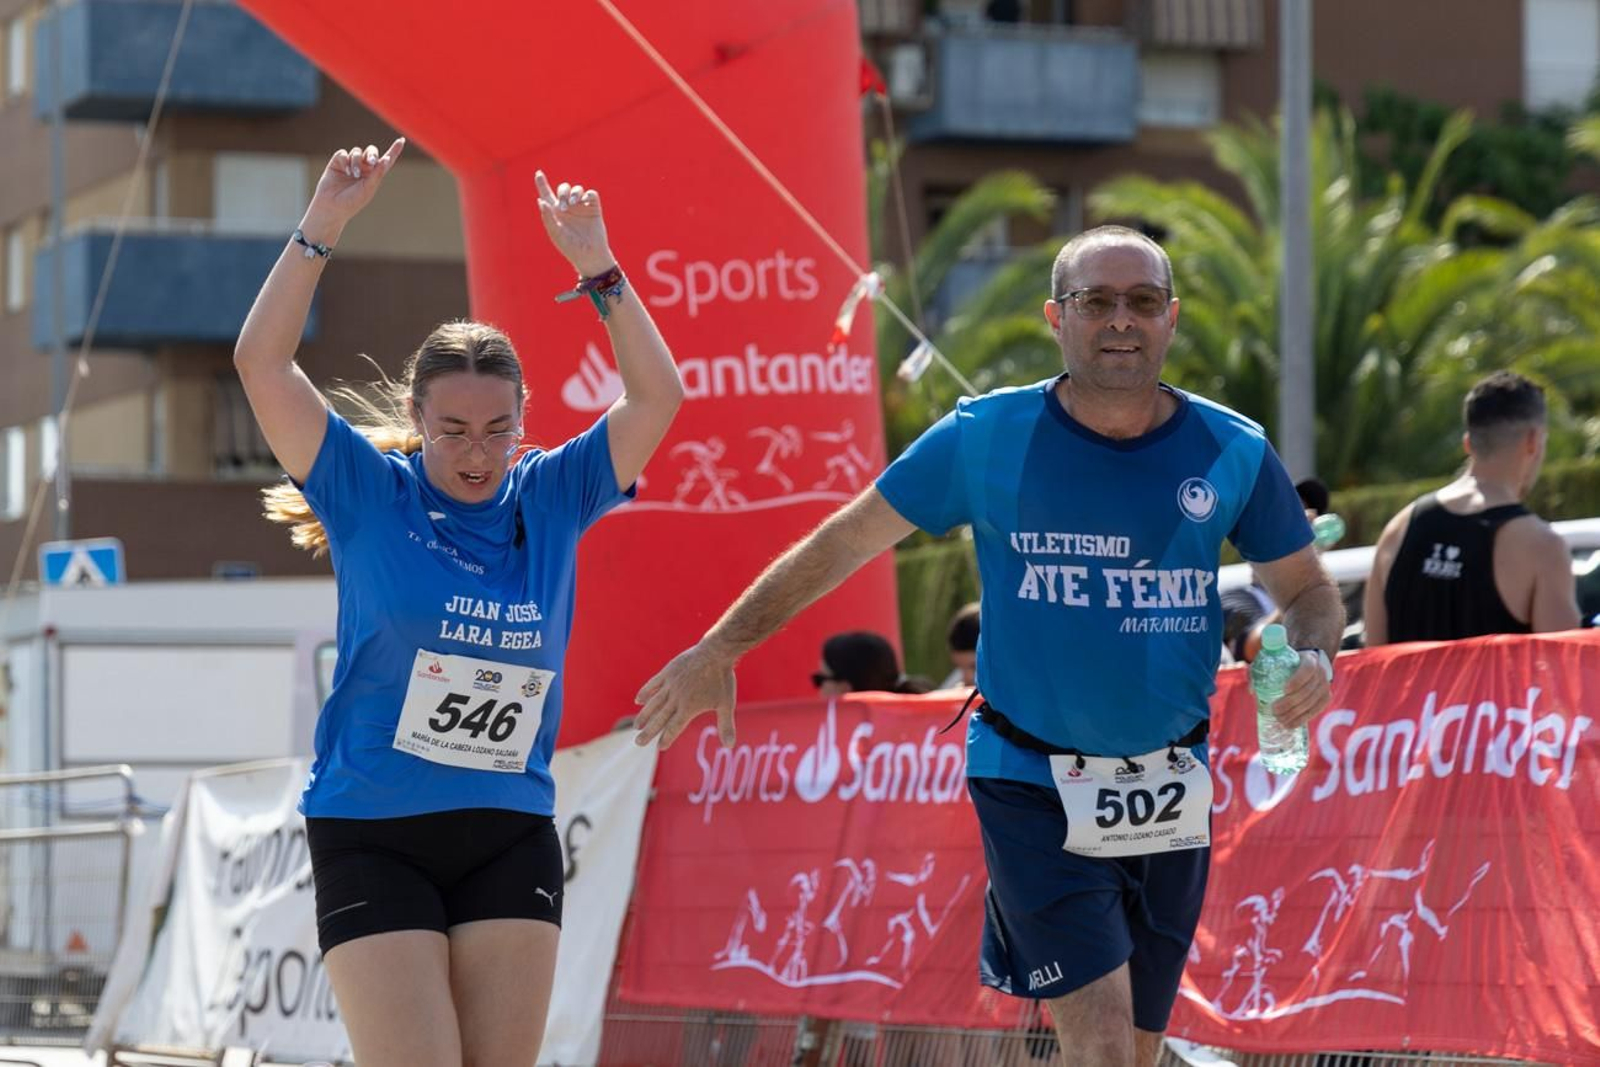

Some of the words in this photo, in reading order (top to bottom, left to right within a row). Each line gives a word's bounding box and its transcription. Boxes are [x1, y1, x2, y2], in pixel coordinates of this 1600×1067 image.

[646, 250, 820, 317] Sports
[680, 343, 873, 399] antander
[444, 595, 502, 621] JUAN
[505, 601, 543, 623] JOSÉ
[439, 620, 493, 647] LARA
[499, 630, 542, 650] EGEA
[428, 692, 522, 742] 546
[430, 739, 440, 747] DE
[440, 741, 449, 749] LA
[1312, 687, 1592, 801] Santander
[688, 726, 798, 824] Sports
[837, 721, 967, 804] Santa
[1095, 782, 1186, 828] 502
